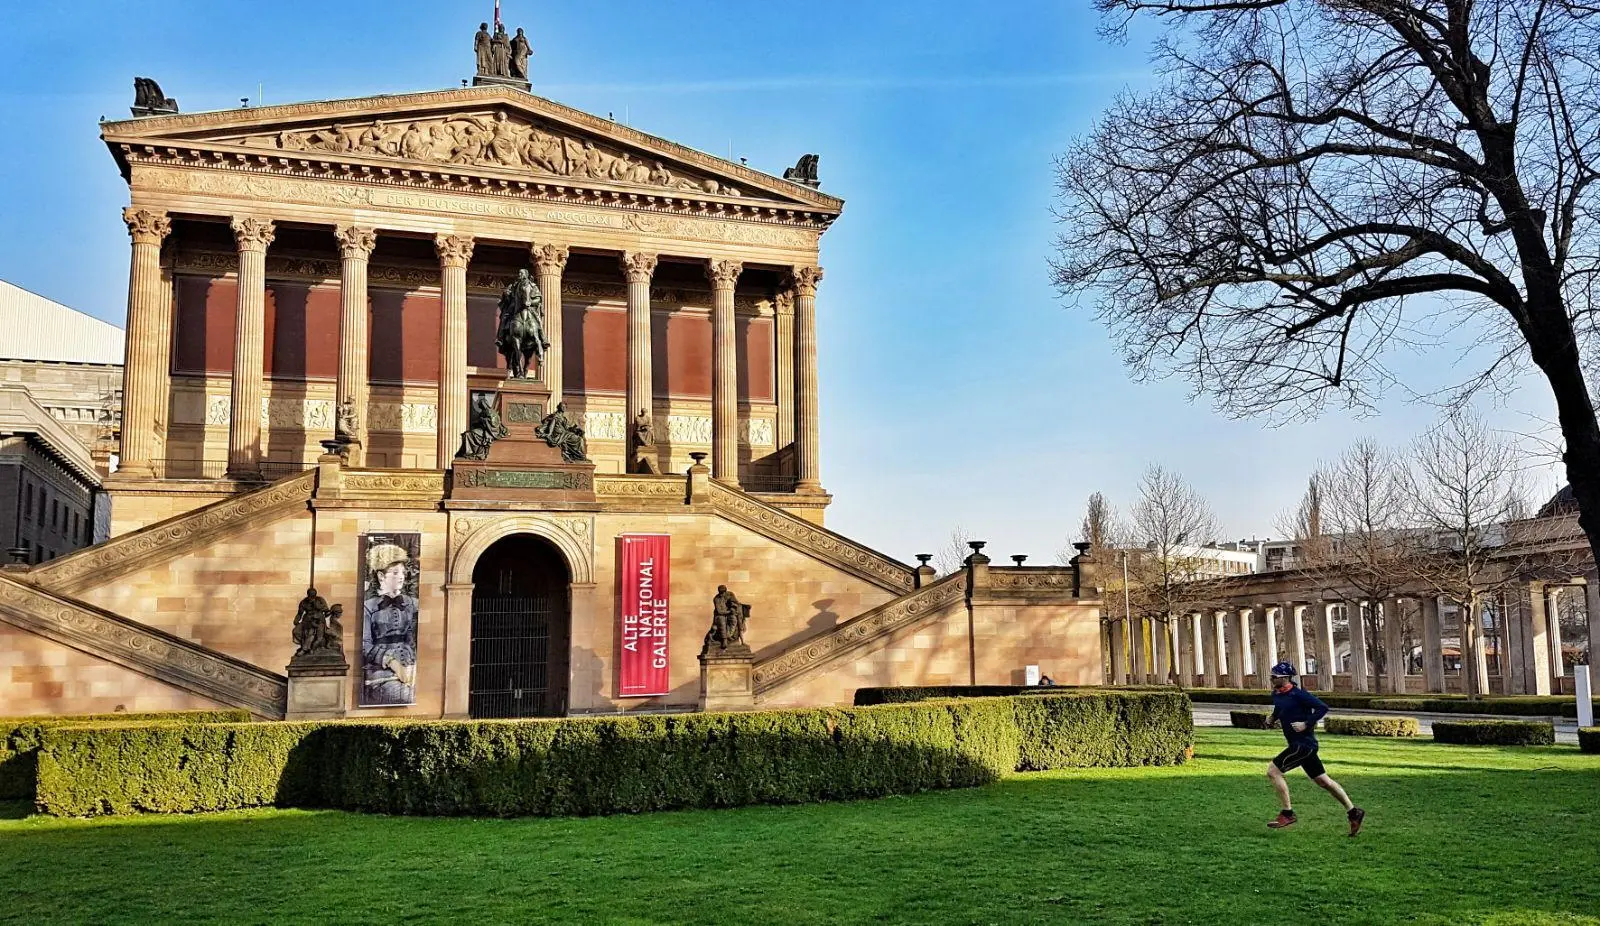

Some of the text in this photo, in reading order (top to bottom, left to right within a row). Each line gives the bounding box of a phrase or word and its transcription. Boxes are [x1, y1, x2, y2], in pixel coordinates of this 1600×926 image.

[387, 194, 411, 205] DER
[418, 198, 490, 213] DEUTSCHEN
[497, 205, 535, 217] KUNST
[639, 557, 653, 638] NATIONAL
[624, 615, 638, 652] ALTE
[652, 598, 667, 669] GALERIE
